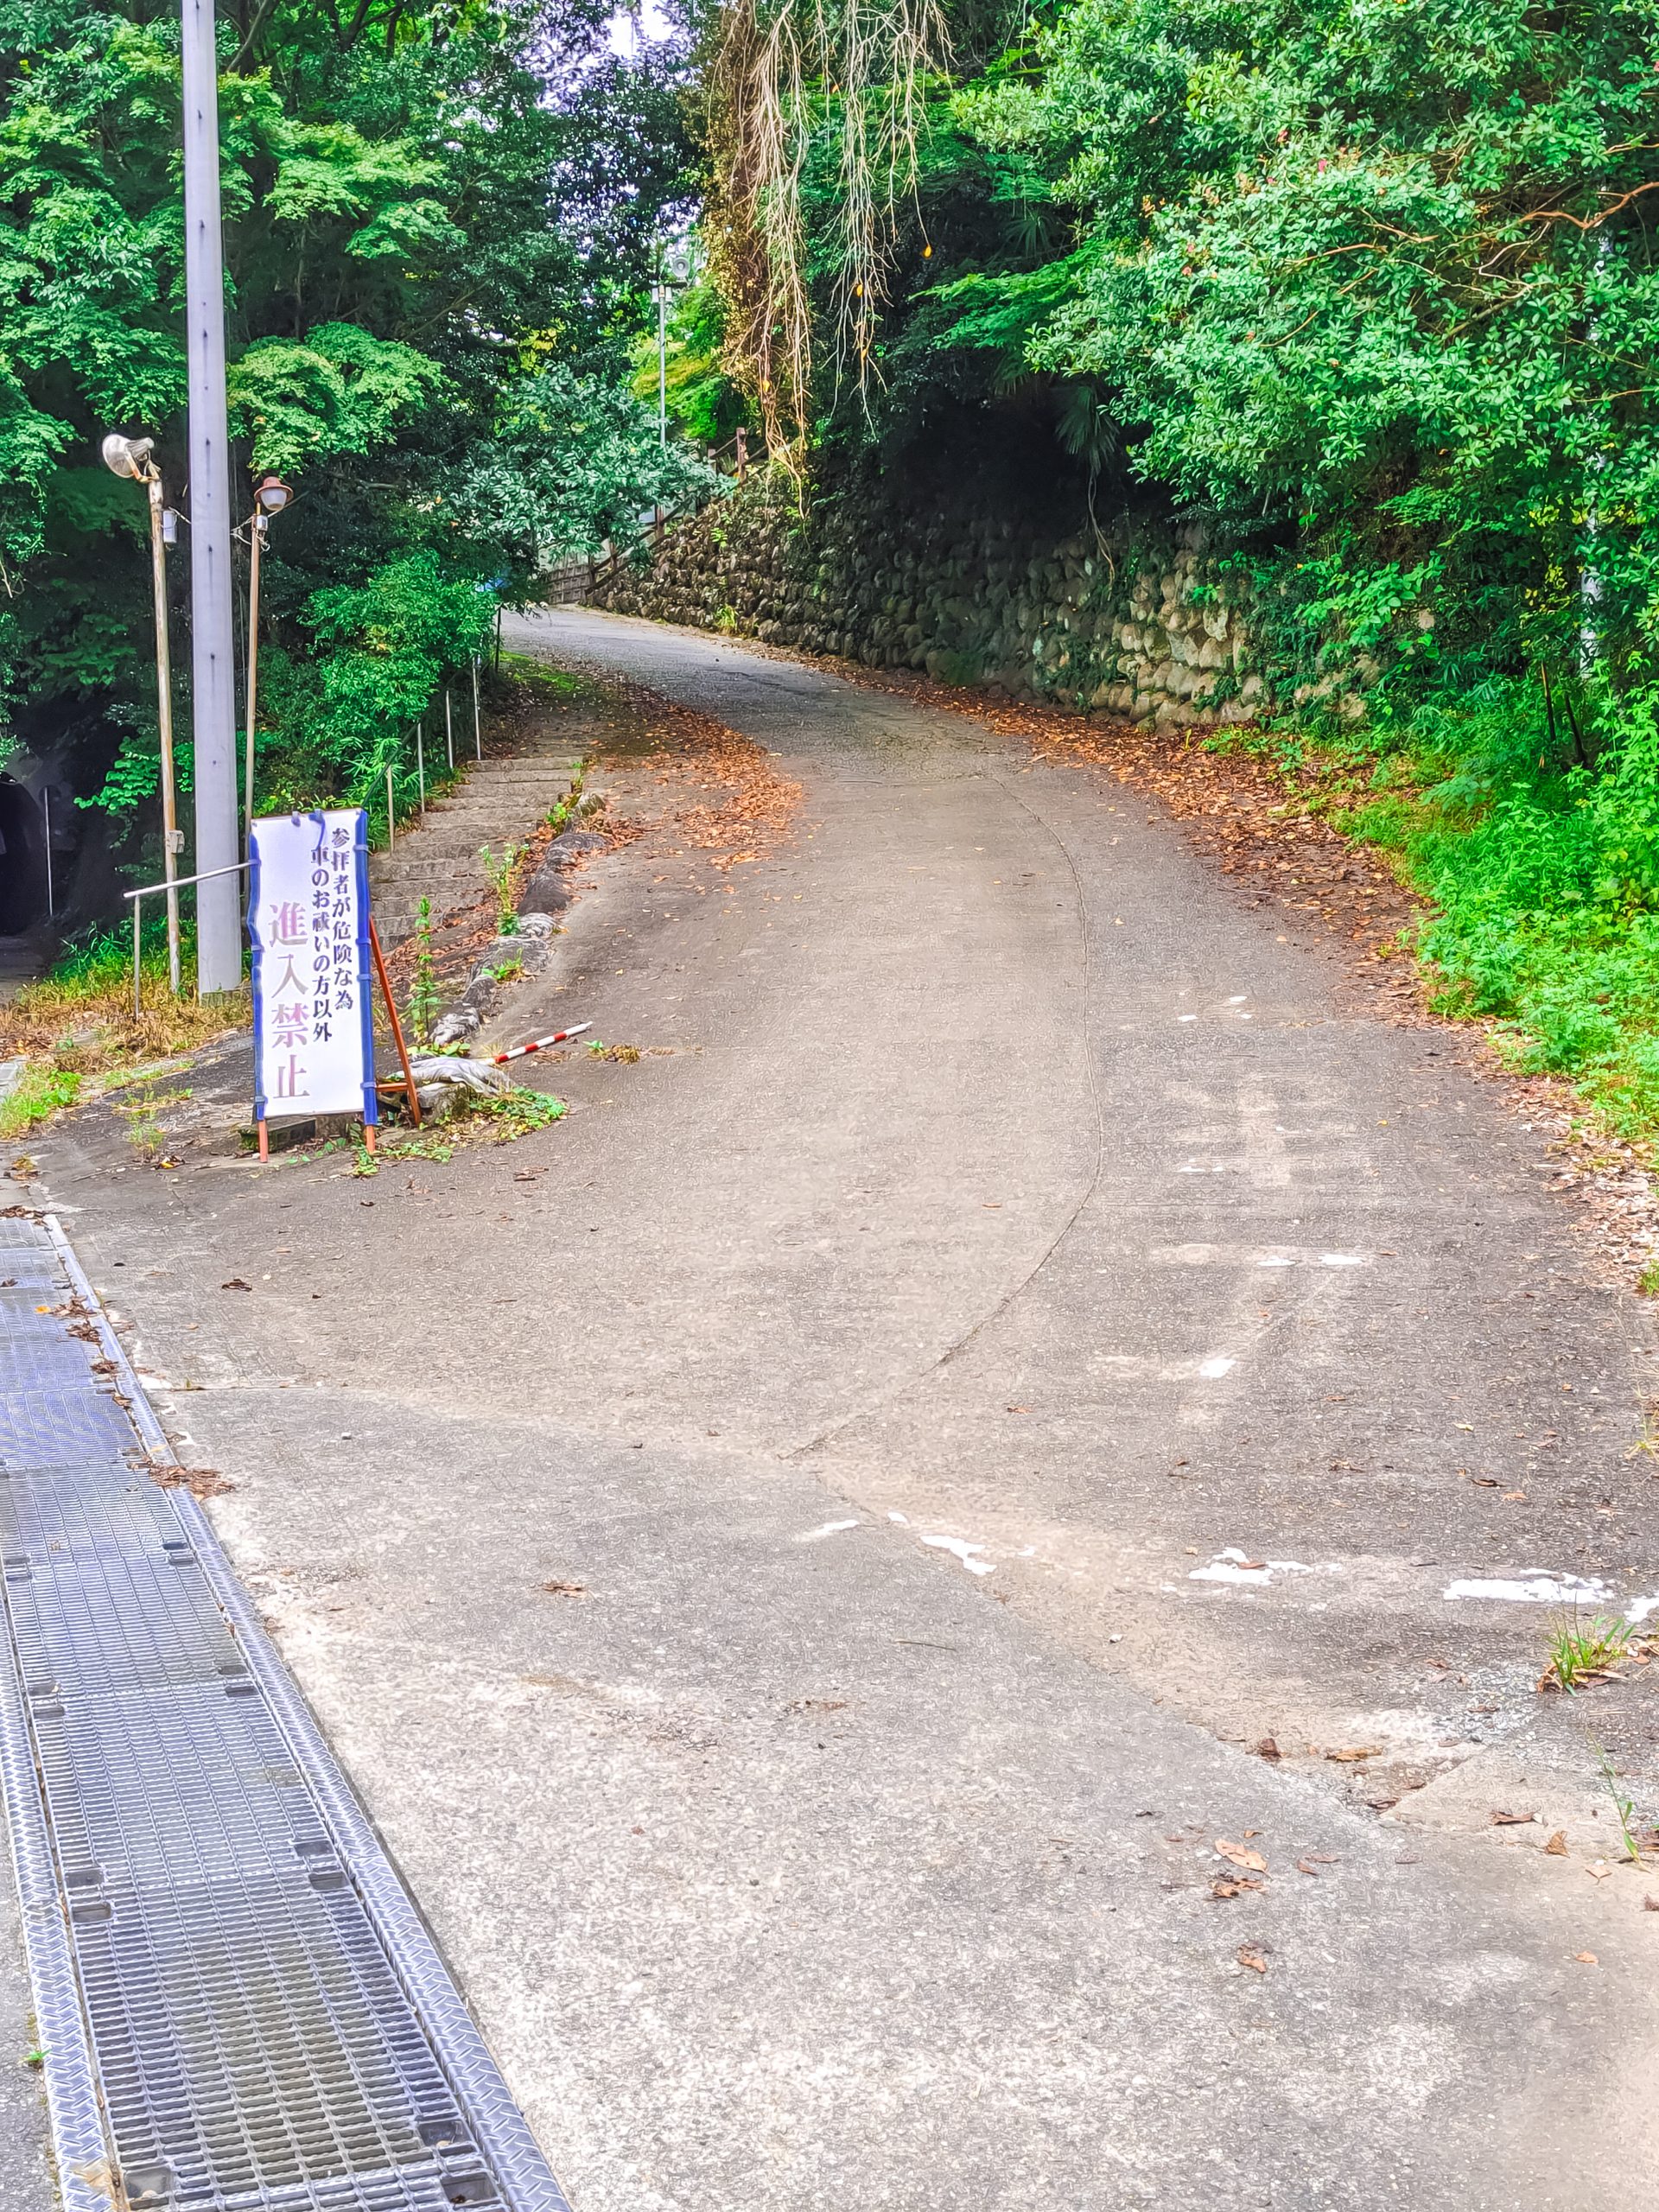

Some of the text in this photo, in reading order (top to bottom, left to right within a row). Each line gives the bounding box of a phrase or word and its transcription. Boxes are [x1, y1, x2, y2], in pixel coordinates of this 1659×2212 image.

[269, 901, 310, 1099] 進入禁止
[311, 846, 333, 1042] 車のお祓いの方以外
[331, 828, 353, 1010] 参拝者が危険な為
